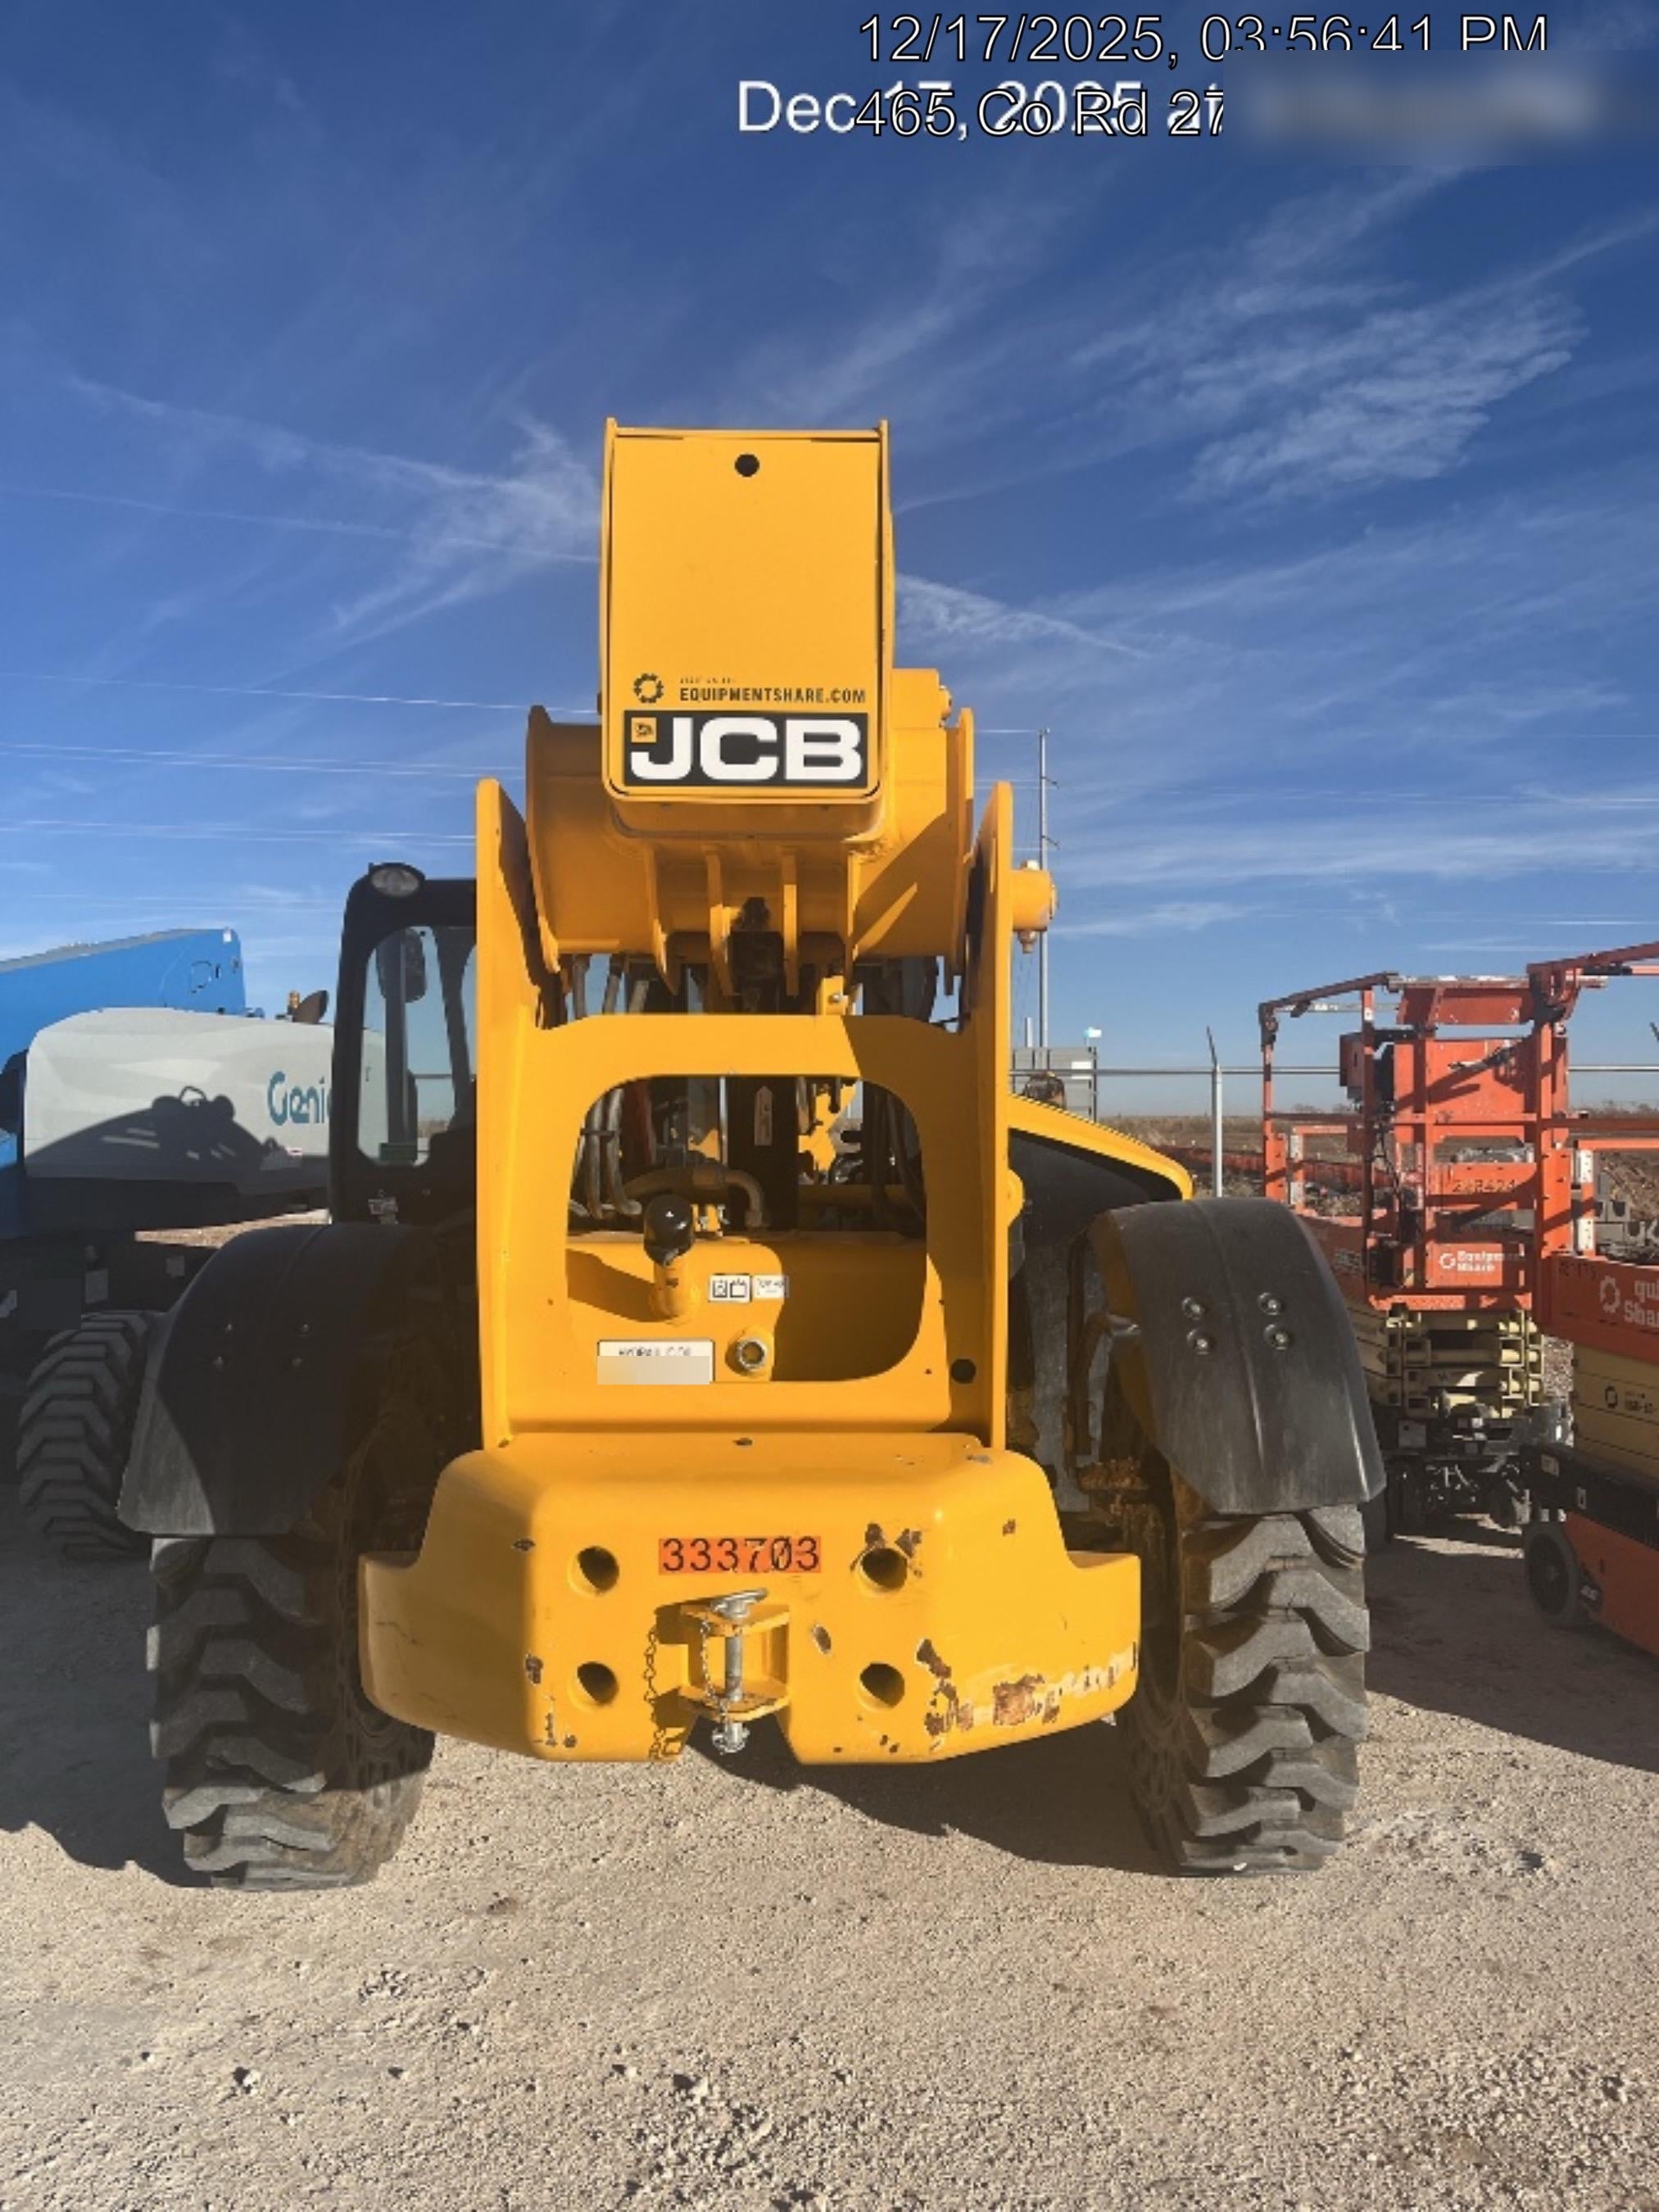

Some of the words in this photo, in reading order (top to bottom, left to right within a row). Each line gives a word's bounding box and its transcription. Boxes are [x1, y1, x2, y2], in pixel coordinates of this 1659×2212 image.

[679, 687, 867, 703] EQUIPMENTSHARE.COM
[629, 717, 863, 782] JCB
[662, 1535, 819, 1572] 333703
